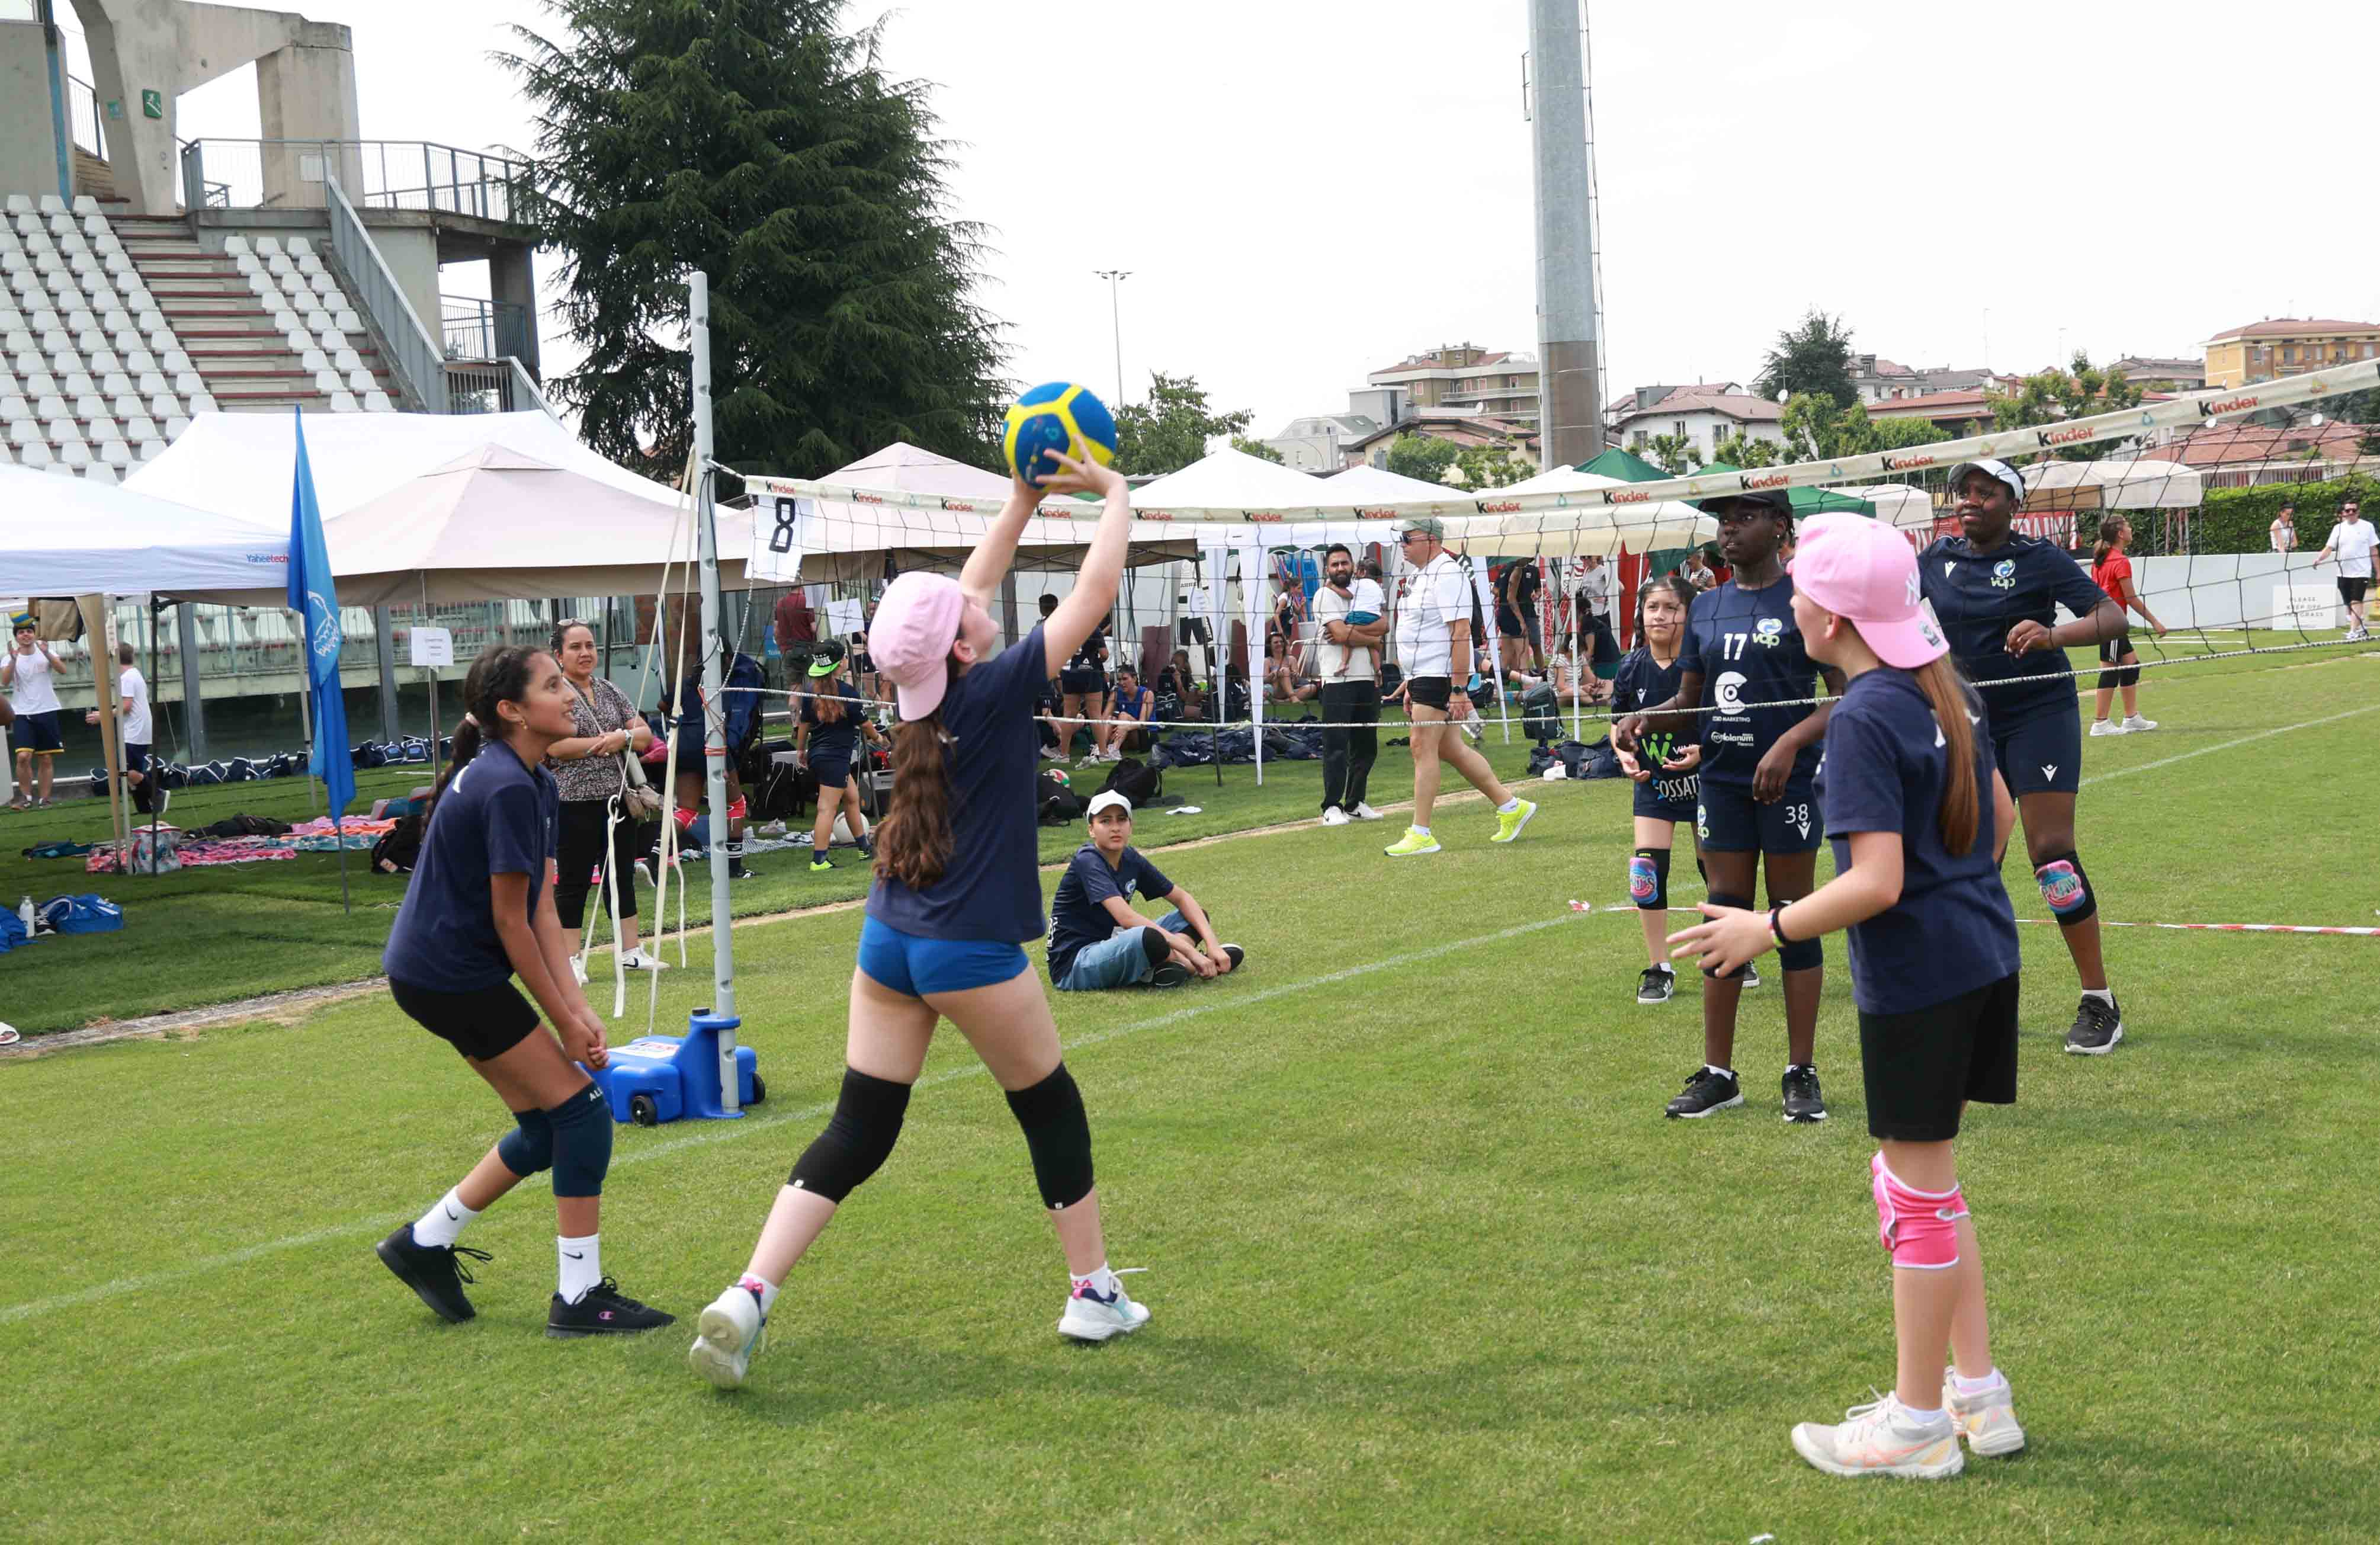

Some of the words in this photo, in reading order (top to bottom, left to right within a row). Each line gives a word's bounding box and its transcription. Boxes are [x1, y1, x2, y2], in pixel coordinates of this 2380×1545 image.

[769, 497, 796, 554] 8
[1724, 633, 1747, 661] 17
[1785, 804, 1808, 823] 38
